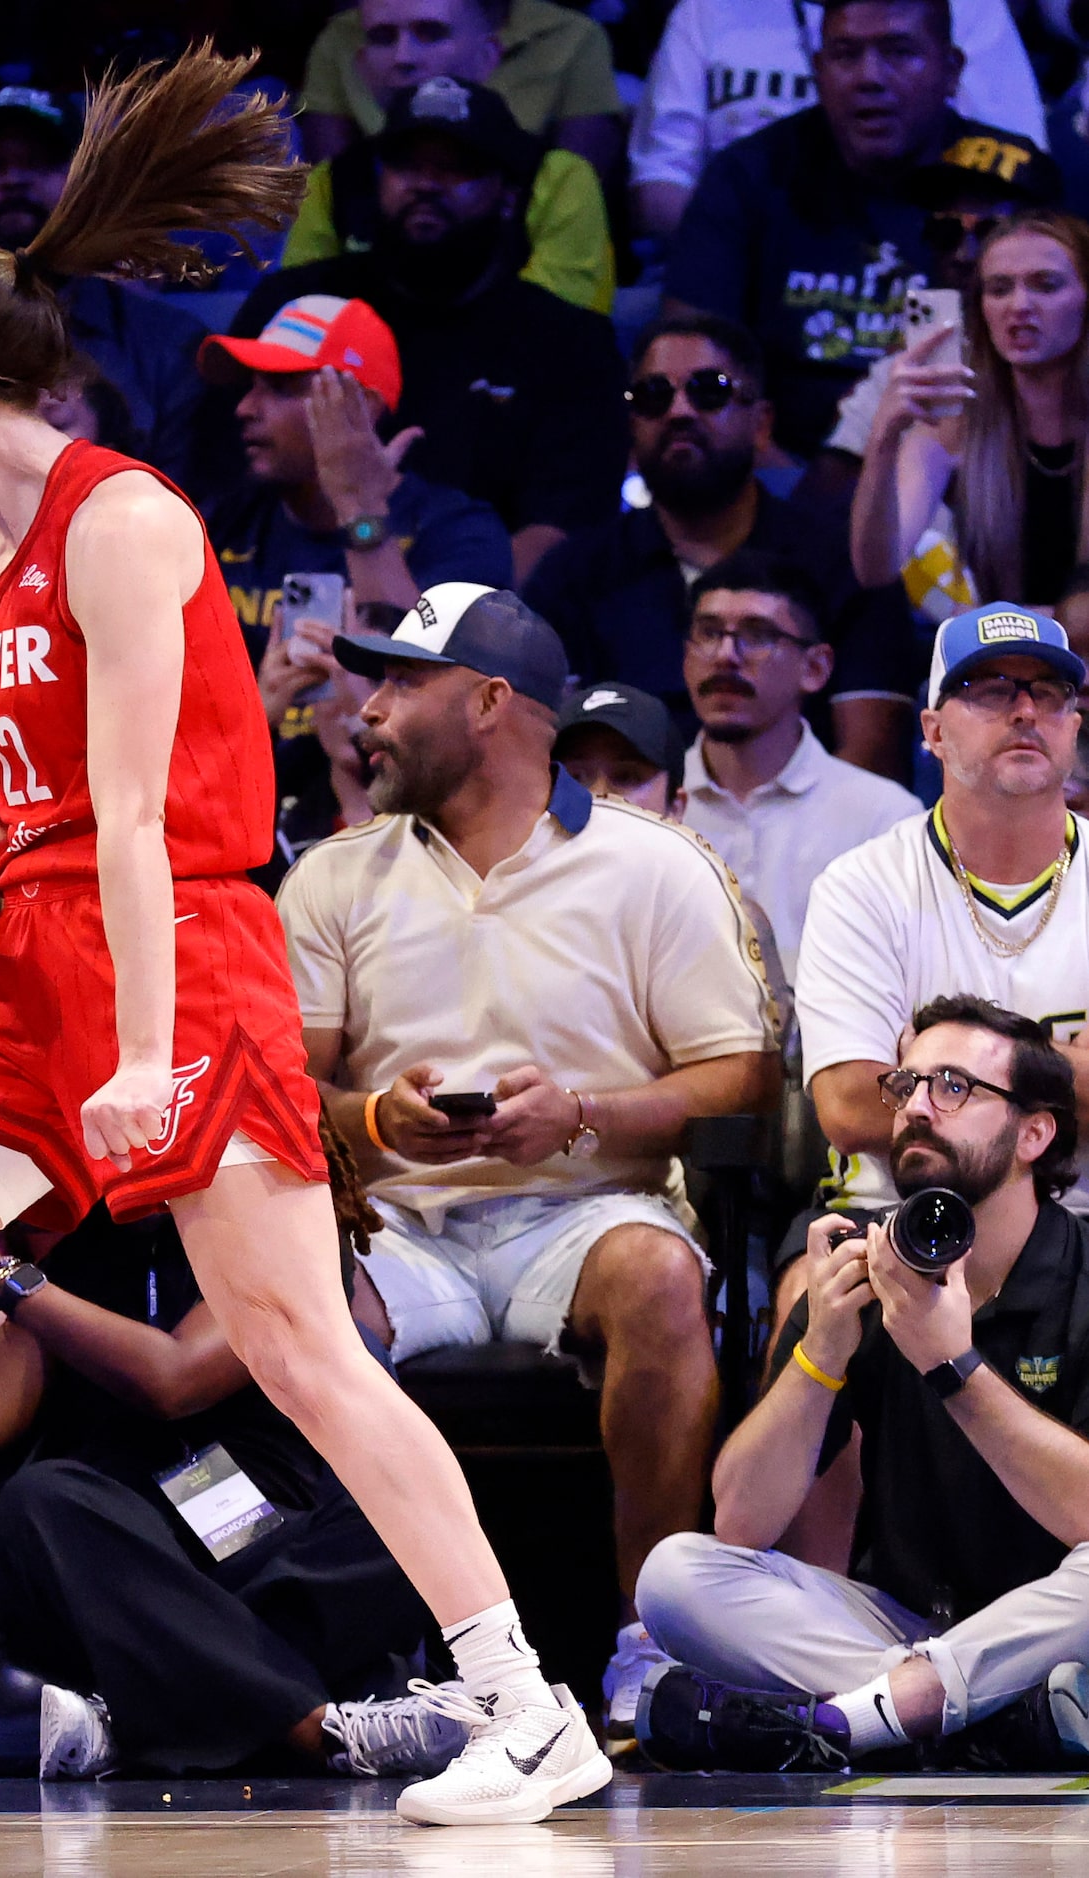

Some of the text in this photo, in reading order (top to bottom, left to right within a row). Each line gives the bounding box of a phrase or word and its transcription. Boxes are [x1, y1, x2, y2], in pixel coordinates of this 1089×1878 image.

[983, 616, 1034, 630] DALLAS
[985, 625, 1035, 640] WINGS
[210, 1507, 265, 1545] BROADCAST
